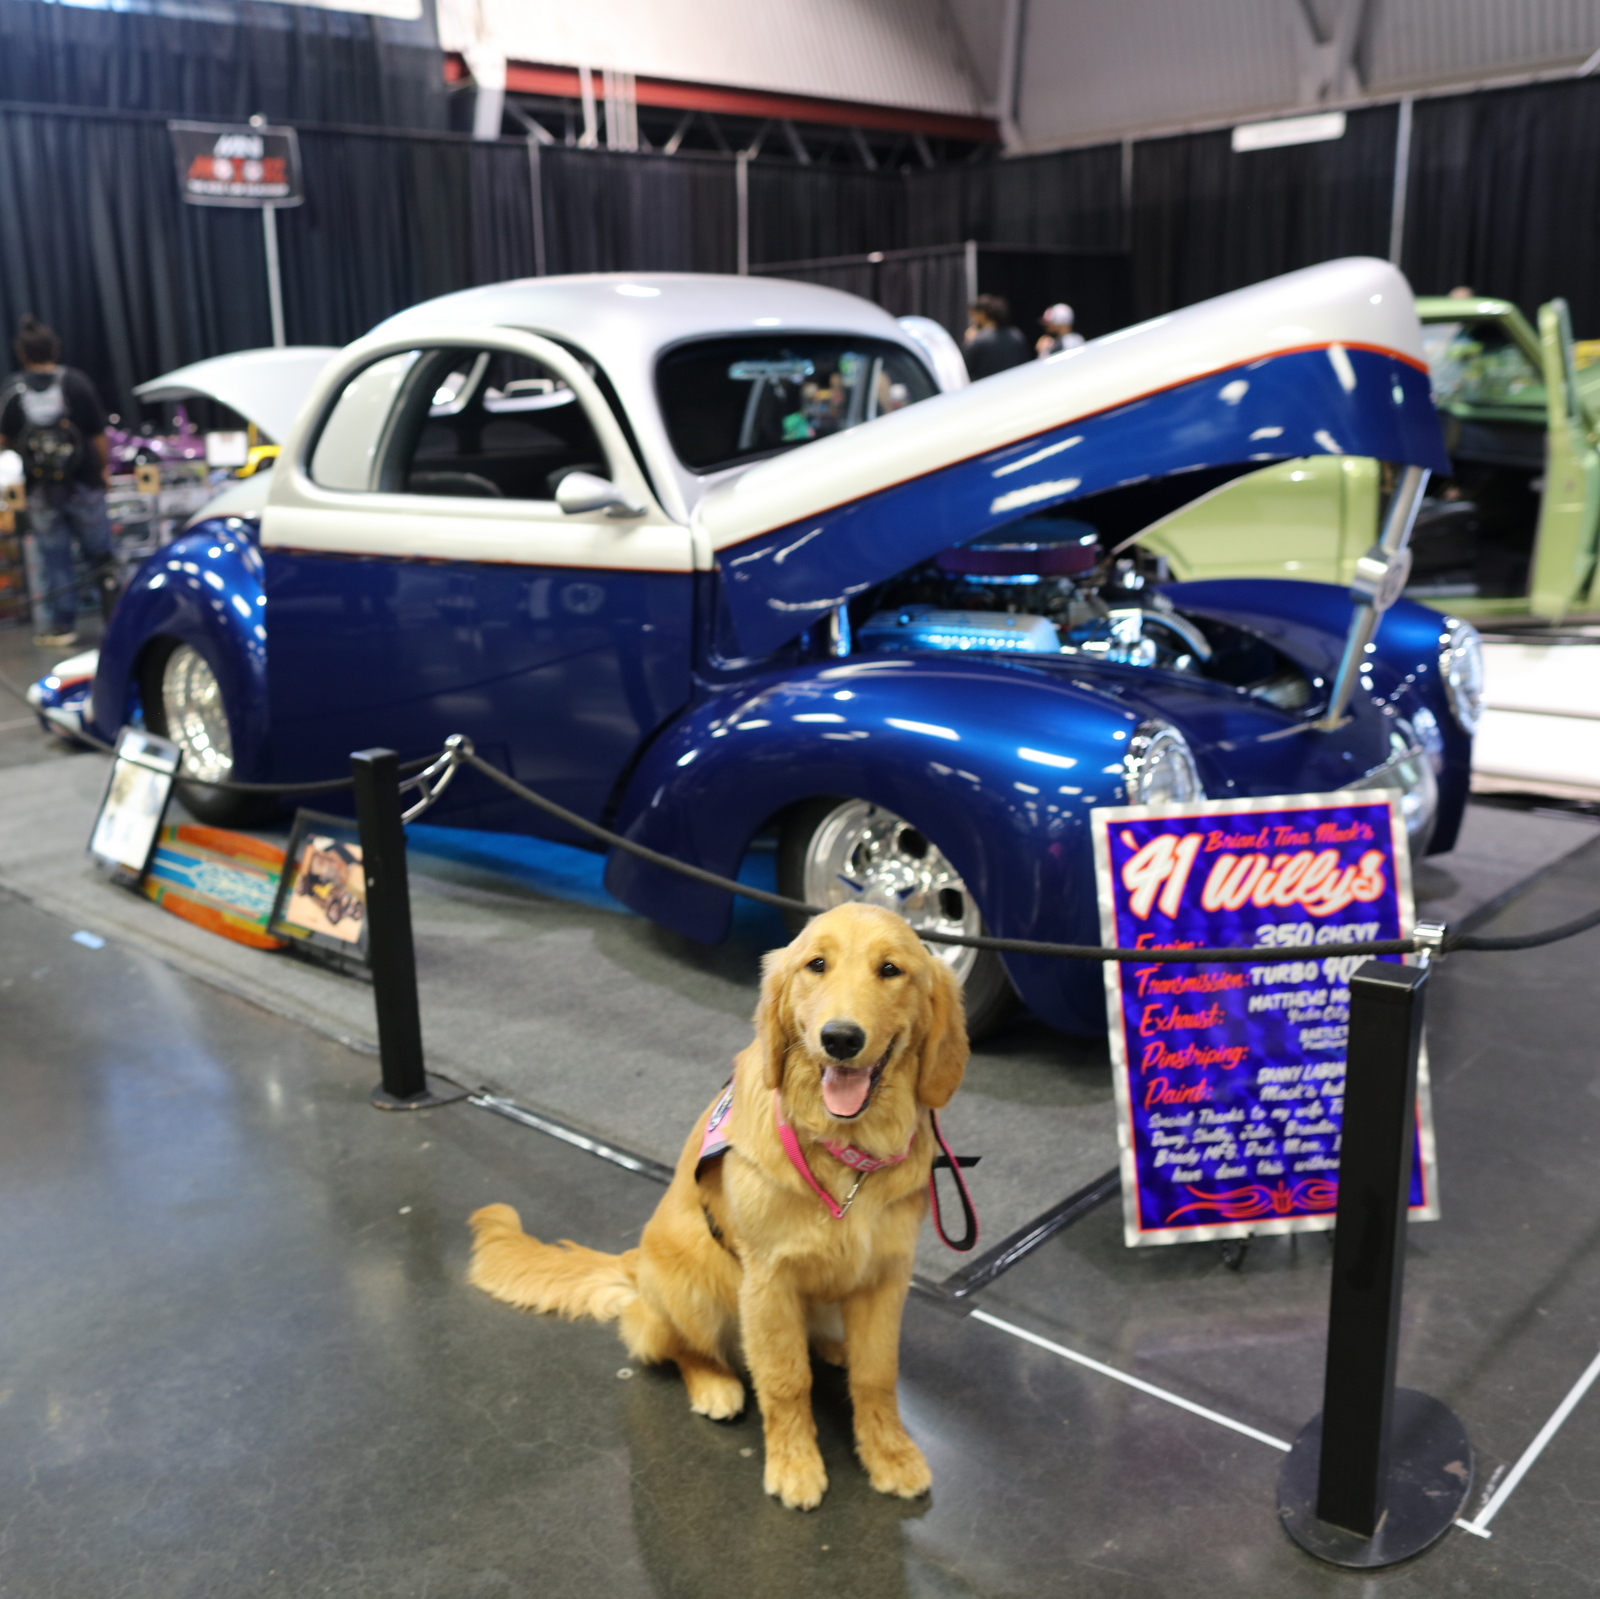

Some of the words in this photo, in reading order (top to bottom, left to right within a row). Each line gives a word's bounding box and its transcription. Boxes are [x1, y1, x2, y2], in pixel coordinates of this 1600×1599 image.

[1273, 826, 1311, 847] Tina
[1314, 820, 1375, 844] Mack's
[1202, 850, 1386, 917] Willys
[1253, 922, 1315, 949] 350
[1316, 922, 1380, 945] CHEVY
[1250, 961, 1319, 986] TURBO
[1139, 1002, 1225, 1037] Exhaust:
[1141, 1041, 1249, 1075] Pinstriping:
[1144, 1077, 1213, 1111] Paint:
[1199, 1107, 1245, 1125] Thanks
[840, 1148, 882, 1172] SE
[1294, 1155, 1341, 1172] withou
